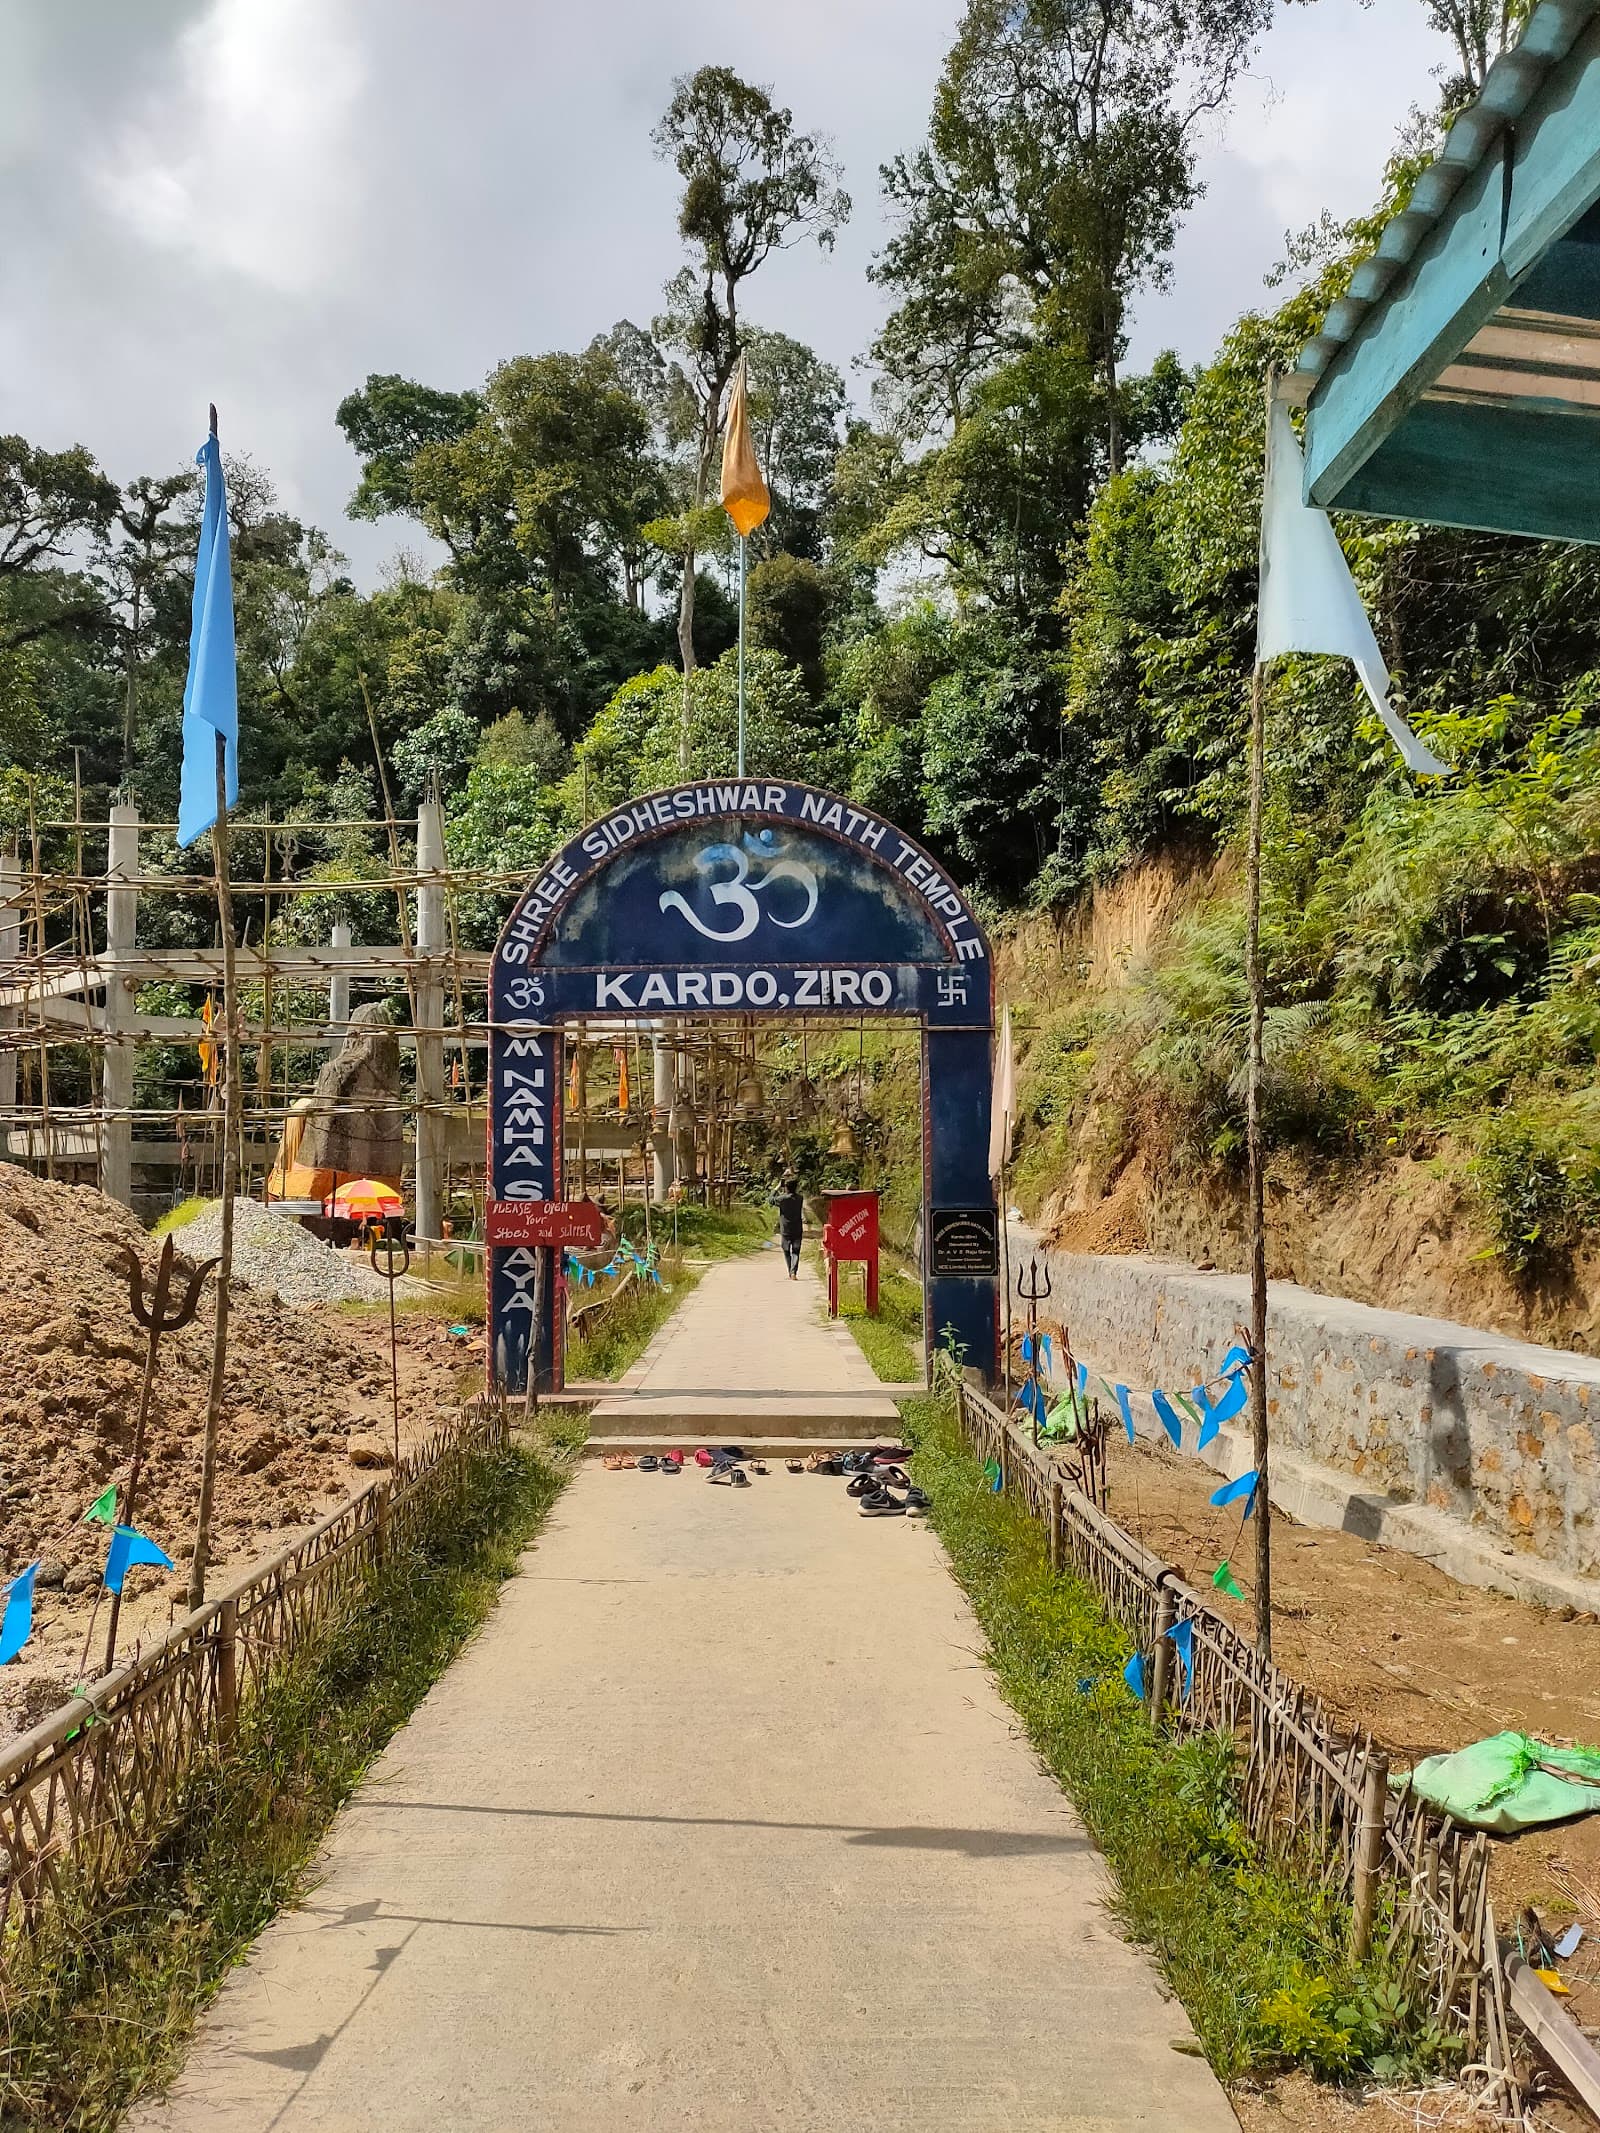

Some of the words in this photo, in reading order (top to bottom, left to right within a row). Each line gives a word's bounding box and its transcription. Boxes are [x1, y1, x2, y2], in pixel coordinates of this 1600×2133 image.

[502, 860, 579, 965] SHREE
[581, 785, 787, 860] SIDHESHWAR
[800, 793, 888, 851] NATH
[892, 839, 985, 962] TEMPLE
[492, 1202, 533, 1216] PLEASE
[838, 1208, 870, 1237] DONATION
[850, 1223, 868, 1243] BOX
